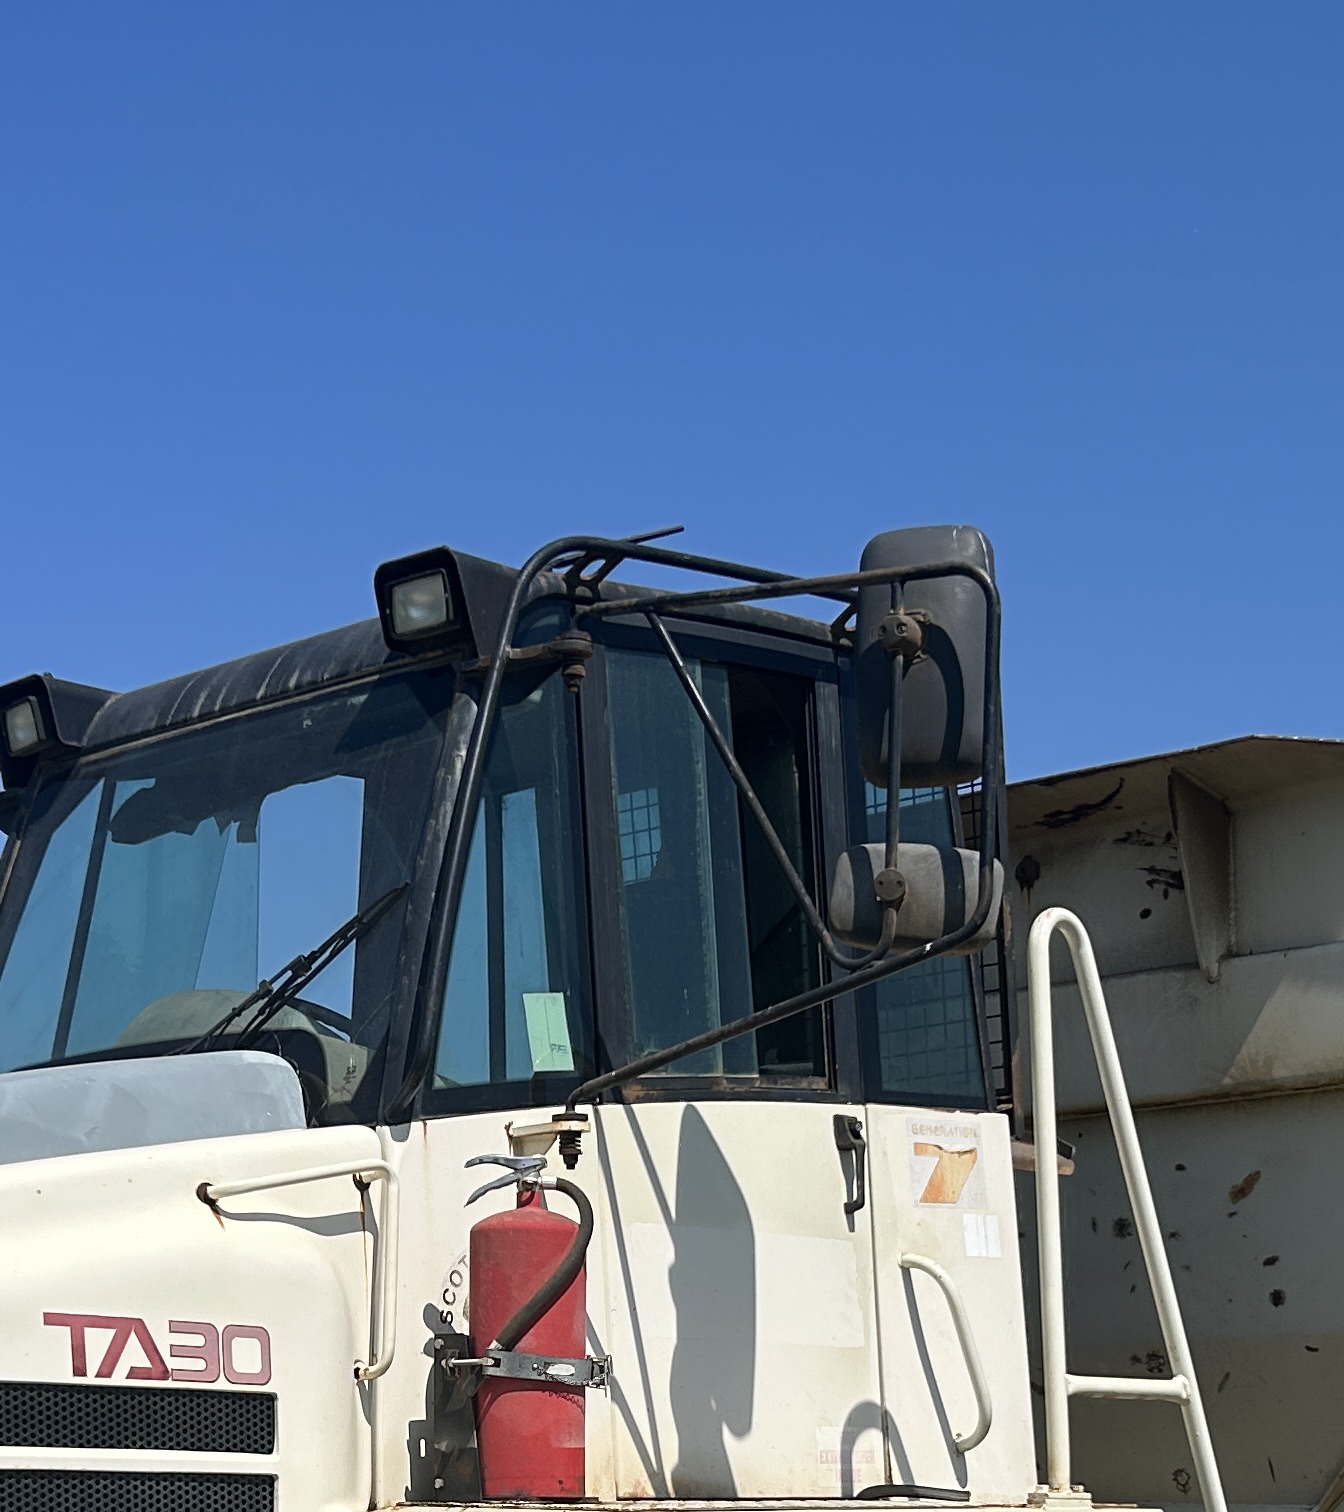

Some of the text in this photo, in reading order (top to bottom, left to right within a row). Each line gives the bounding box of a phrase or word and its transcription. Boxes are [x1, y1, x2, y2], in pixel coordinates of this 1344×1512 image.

[911, 1123, 978, 1139] GENERATION
[913, 1142, 978, 1204] 7
[43, 1312, 272, 1385] TA30
